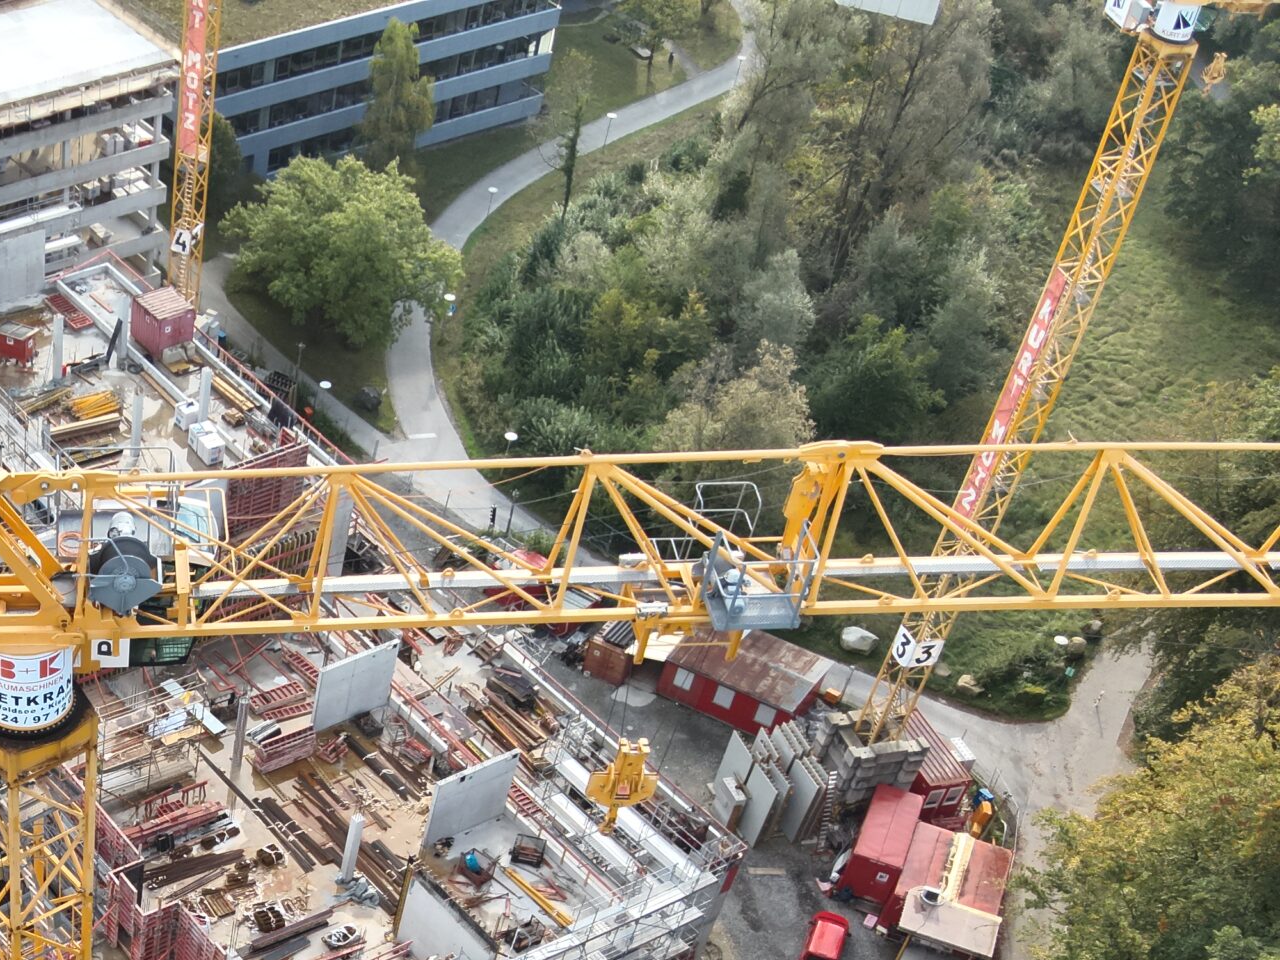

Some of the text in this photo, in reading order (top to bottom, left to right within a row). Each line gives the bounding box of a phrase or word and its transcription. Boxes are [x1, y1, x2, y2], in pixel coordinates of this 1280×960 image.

[185, 50, 201, 131] MOTZ
[175, 232, 187, 252] 4
[1010, 299, 1051, 397] KURT
[897, 633, 911, 658] 3
[915, 645, 936, 664] 3
[33, 713, 50, 723] 97
